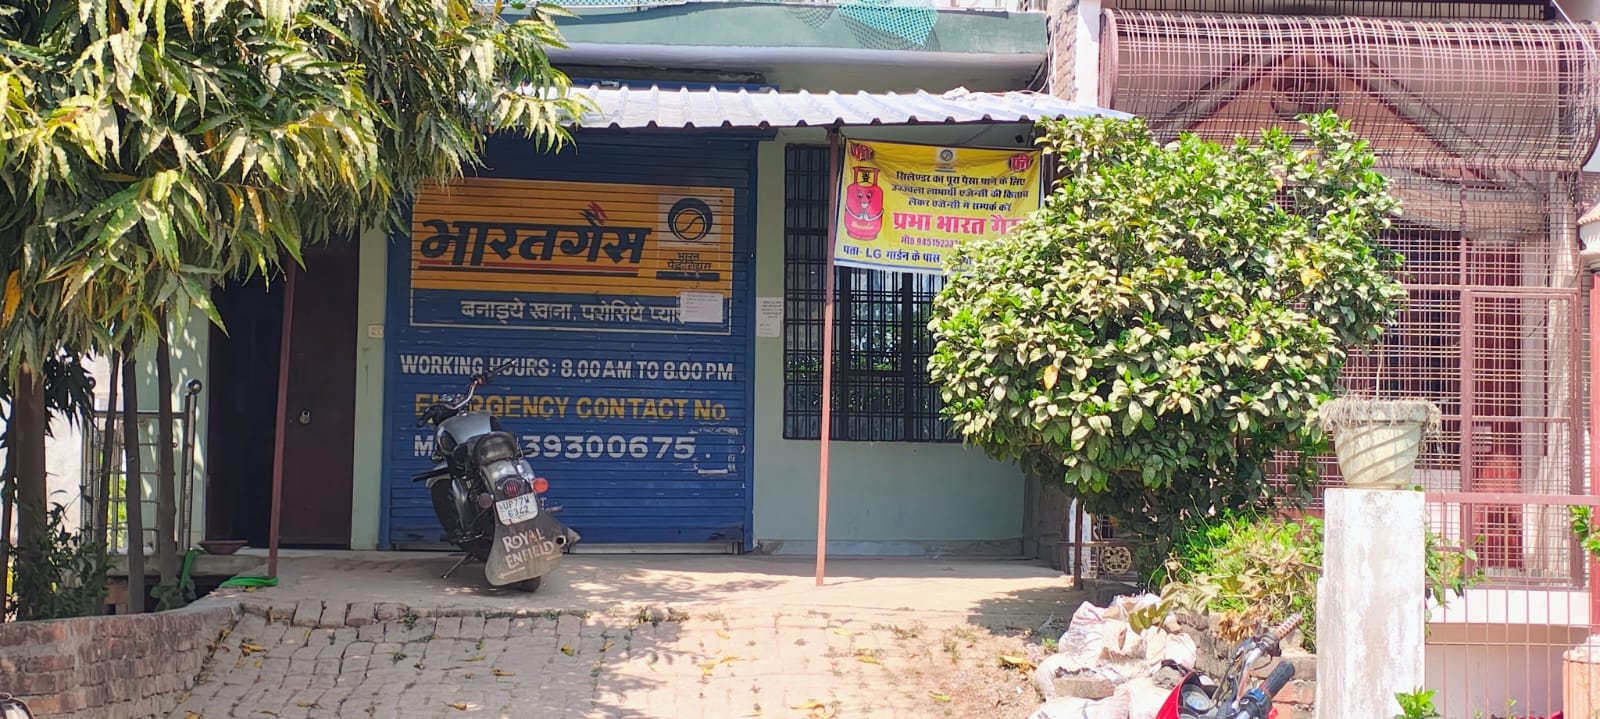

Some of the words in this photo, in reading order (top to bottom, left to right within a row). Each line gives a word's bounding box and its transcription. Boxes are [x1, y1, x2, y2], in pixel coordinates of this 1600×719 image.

[933, 174, 944, 184] का
[946, 175, 960, 187] पूरा
[962, 174, 979, 185] पैसा
[981, 176, 997, 186] पाने
[999, 176, 1008, 185] के
[1010, 176, 1026, 186] लिए
[908, 197, 930, 207] लेकर
[990, 188, 1002, 198] की
[893, 212, 933, 231] प्रभा
[936, 215, 987, 235] भारत
[866, 248, 882, 258] LG
[911, 250, 921, 261] के
[923, 253, 940, 263] पास
[400, 355, 483, 375] WORKING
[636, 361, 659, 379] TO
[415, 393, 569, 420] ERGENCY
[576, 397, 688, 420] CONTACT
[502, 528, 545, 552] ROYAL
[504, 541, 554, 570] ENFIELD
